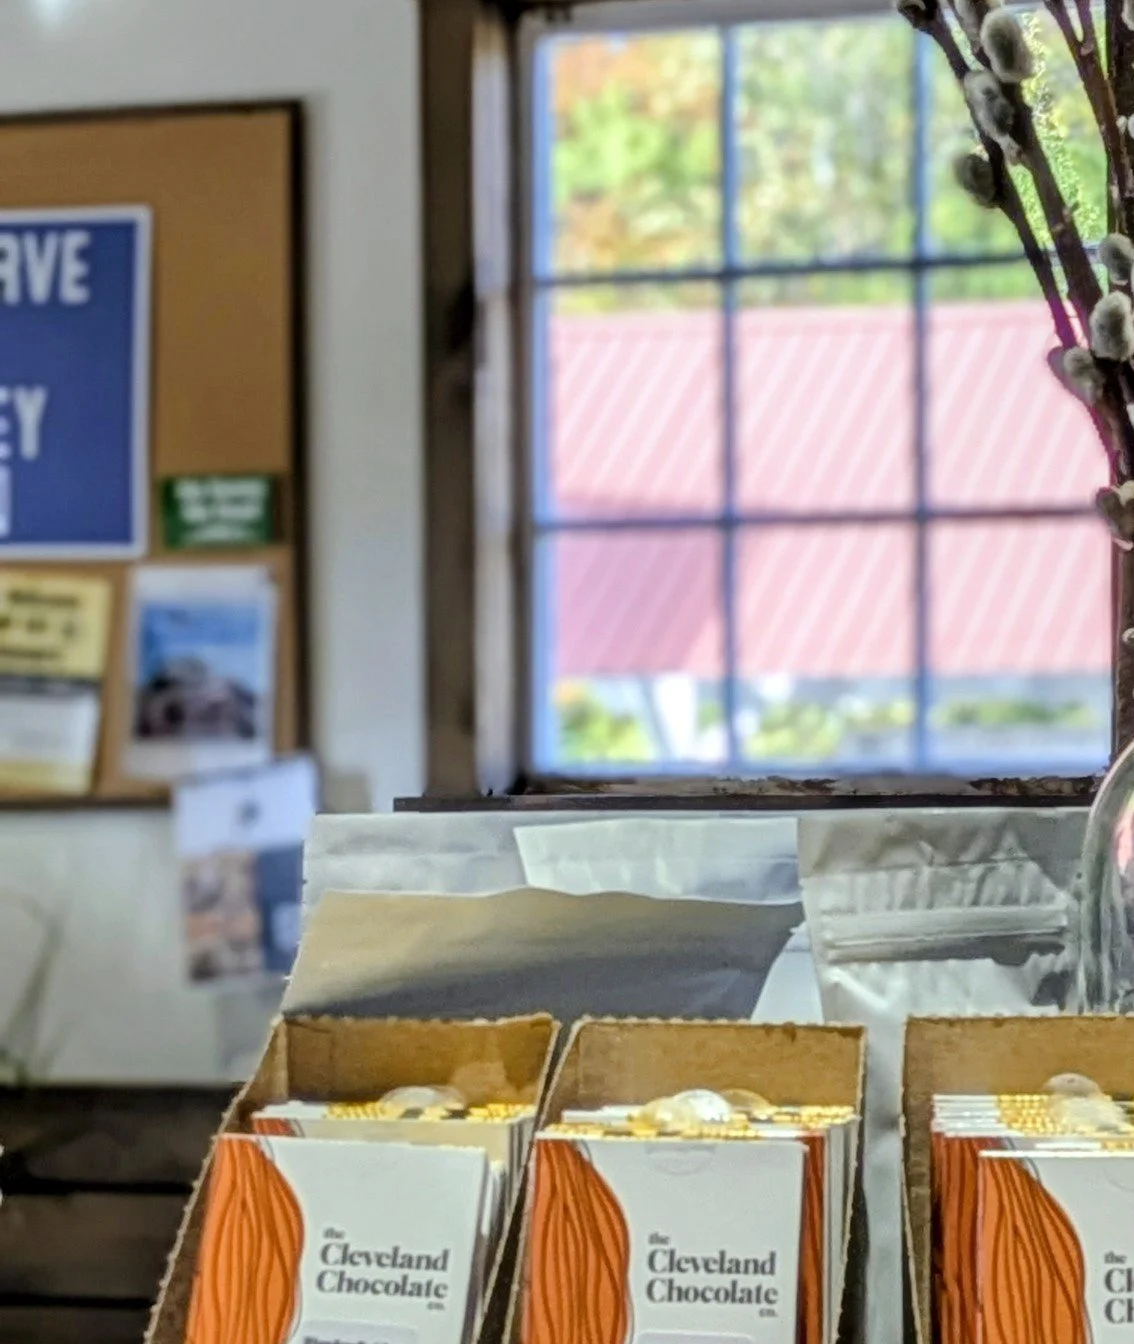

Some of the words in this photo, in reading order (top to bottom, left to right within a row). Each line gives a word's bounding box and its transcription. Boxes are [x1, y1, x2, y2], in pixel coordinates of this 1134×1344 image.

[323, 1228, 346, 1240] the
[648, 1233, 669, 1244] the
[320, 1242, 450, 1273] Cleveland
[647, 1249, 776, 1276] Cleveland
[1104, 1251, 1127, 1264] the
[316, 1270, 449, 1299] Chocolate
[646, 1279, 778, 1305] Chocolate
